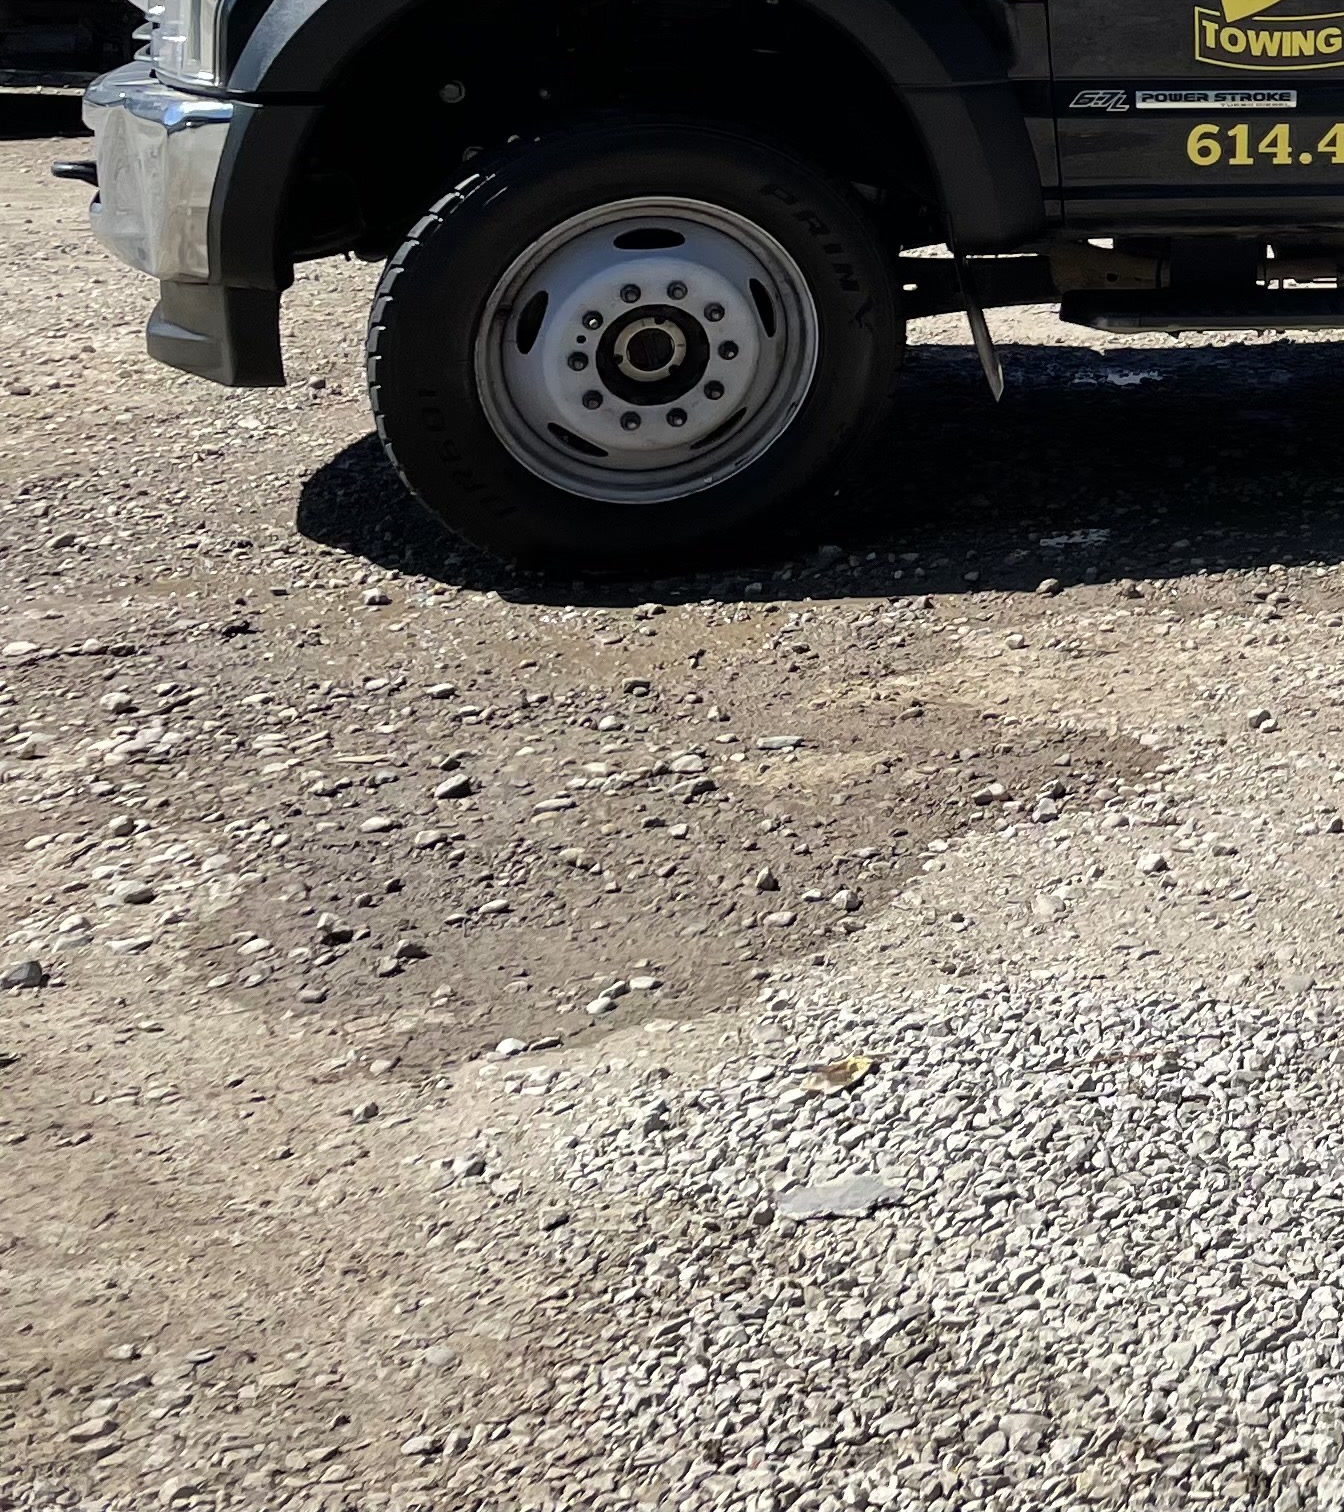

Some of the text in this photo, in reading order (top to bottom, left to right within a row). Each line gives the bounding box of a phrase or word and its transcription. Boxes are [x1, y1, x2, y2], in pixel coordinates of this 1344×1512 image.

[1201, 19, 1343, 57] TOWING
[1141, 92, 1291, 103] POWER STROKE
